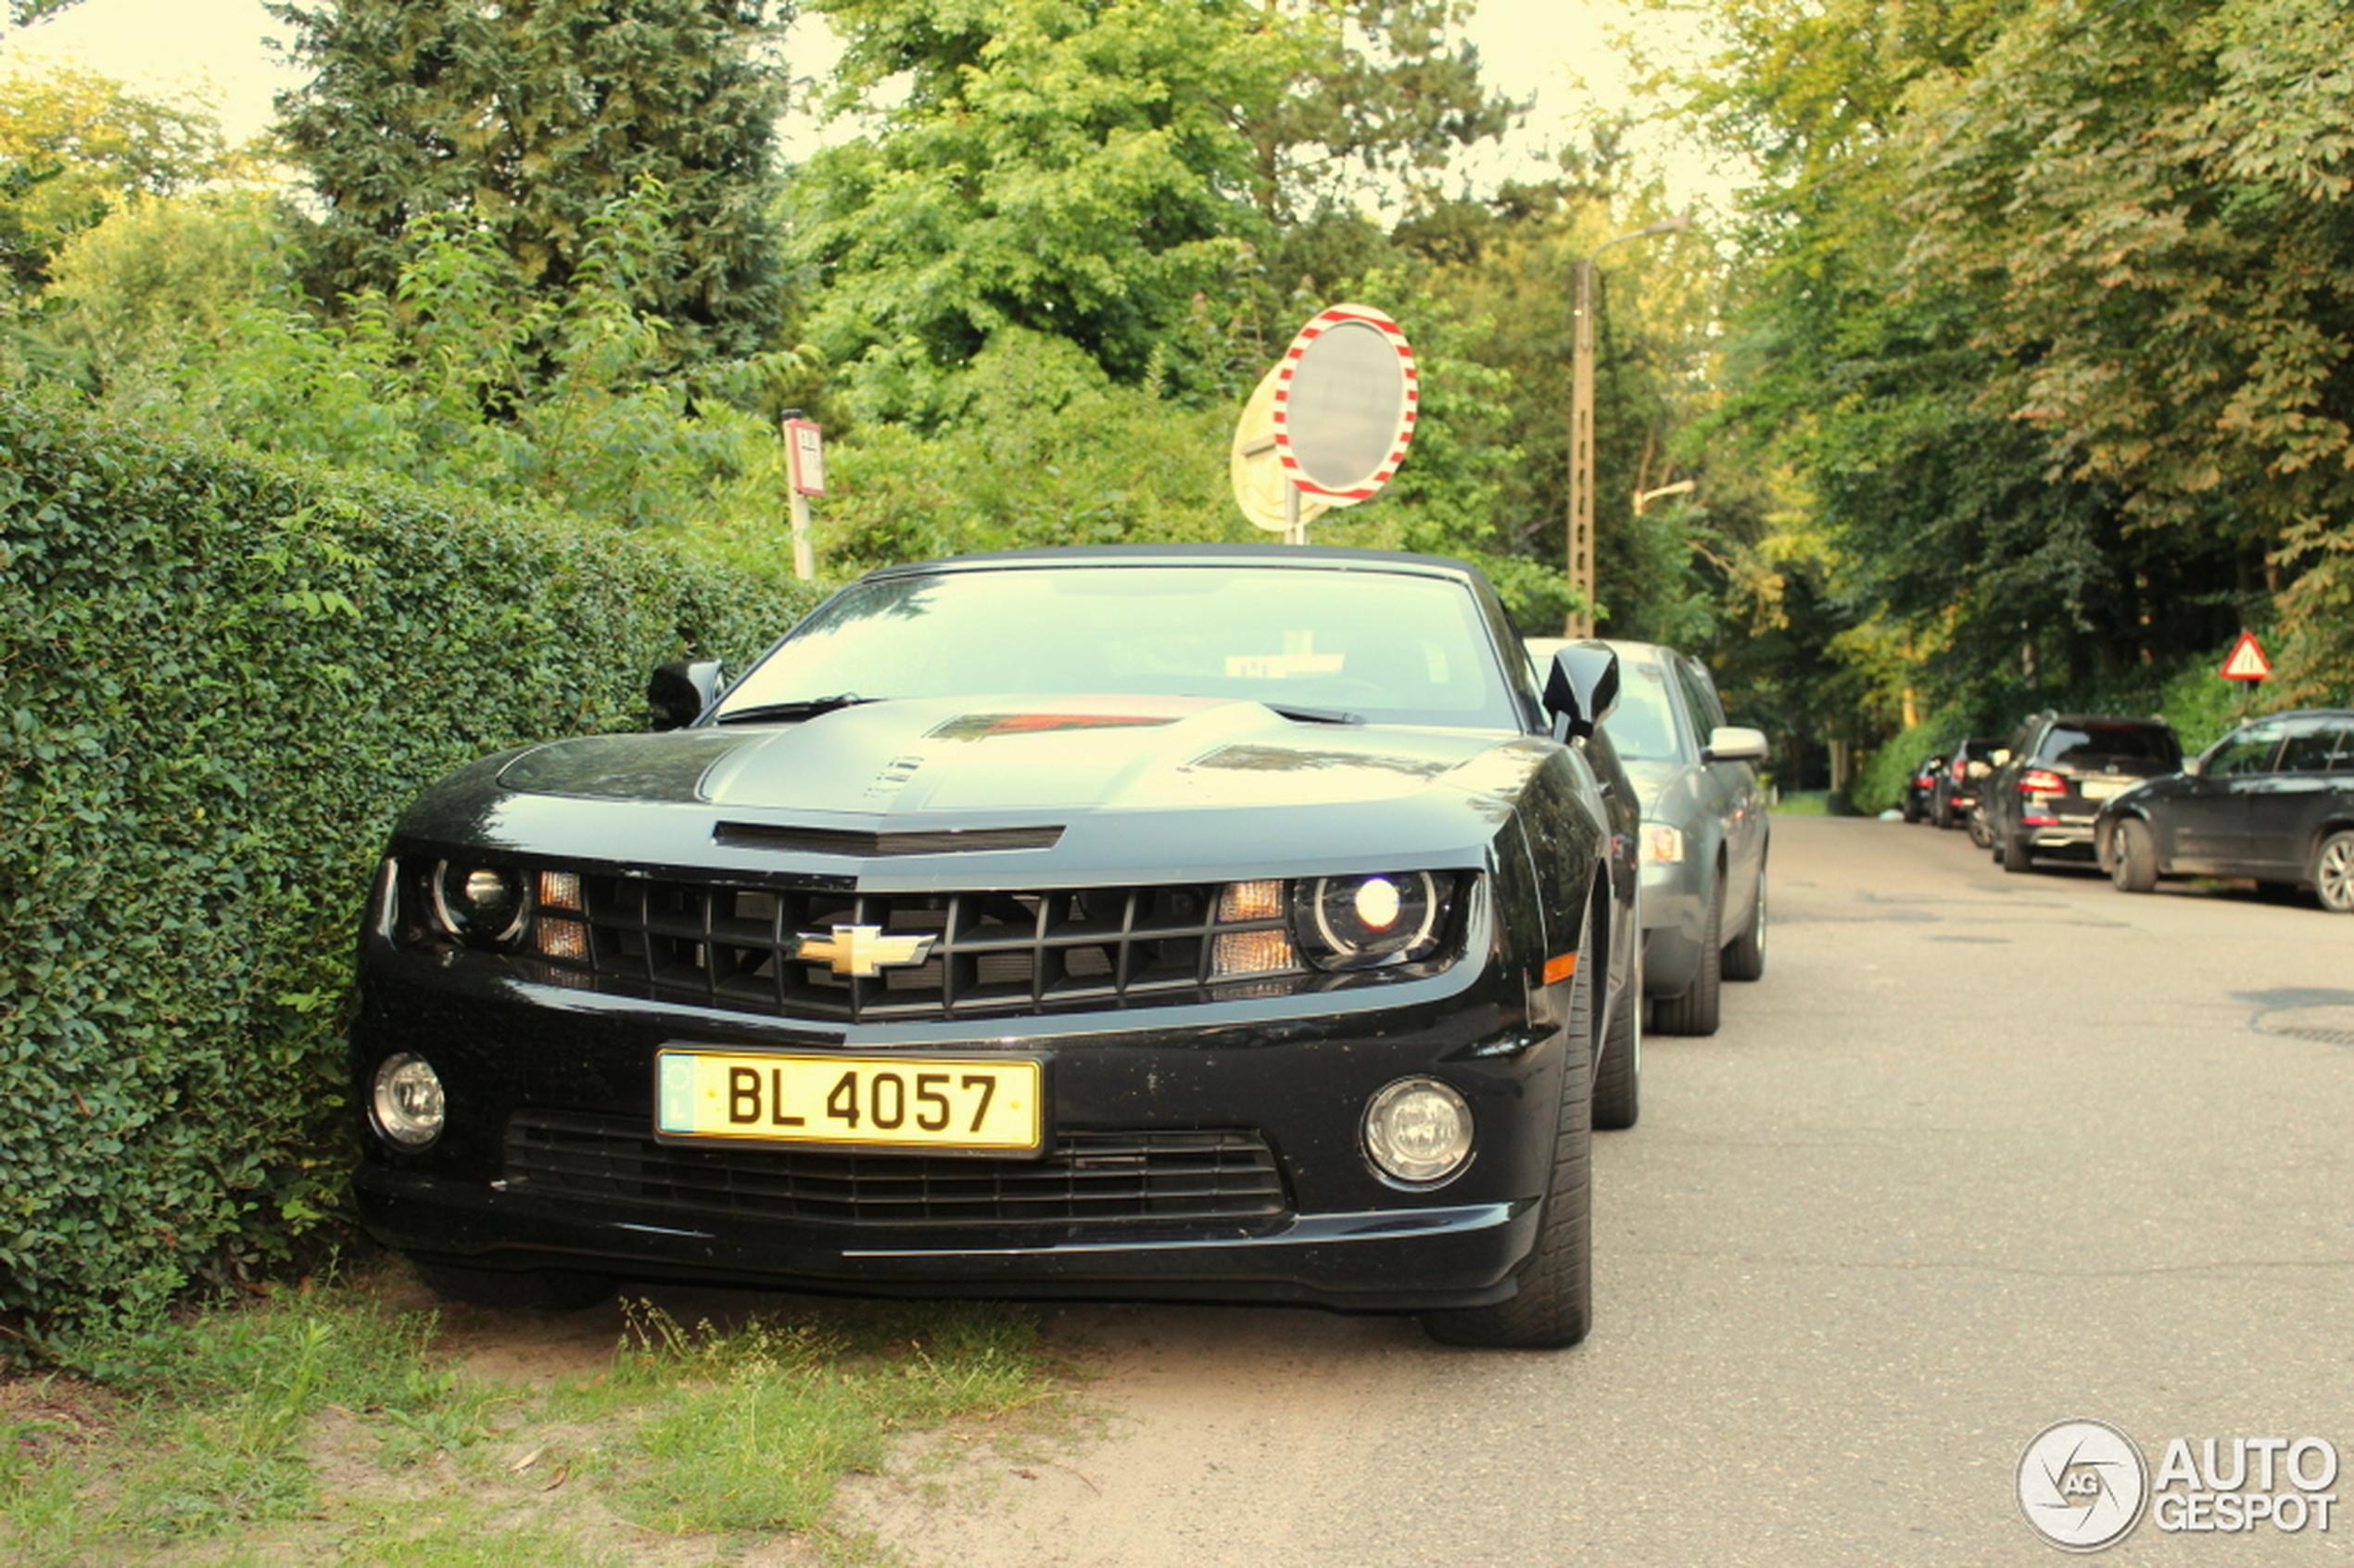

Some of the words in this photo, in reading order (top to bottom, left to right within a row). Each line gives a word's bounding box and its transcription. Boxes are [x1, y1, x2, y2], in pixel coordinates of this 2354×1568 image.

[670, 1098, 686, 1119] L
[728, 1067, 804, 1126] BL
[827, 1071, 996, 1132] 4057
